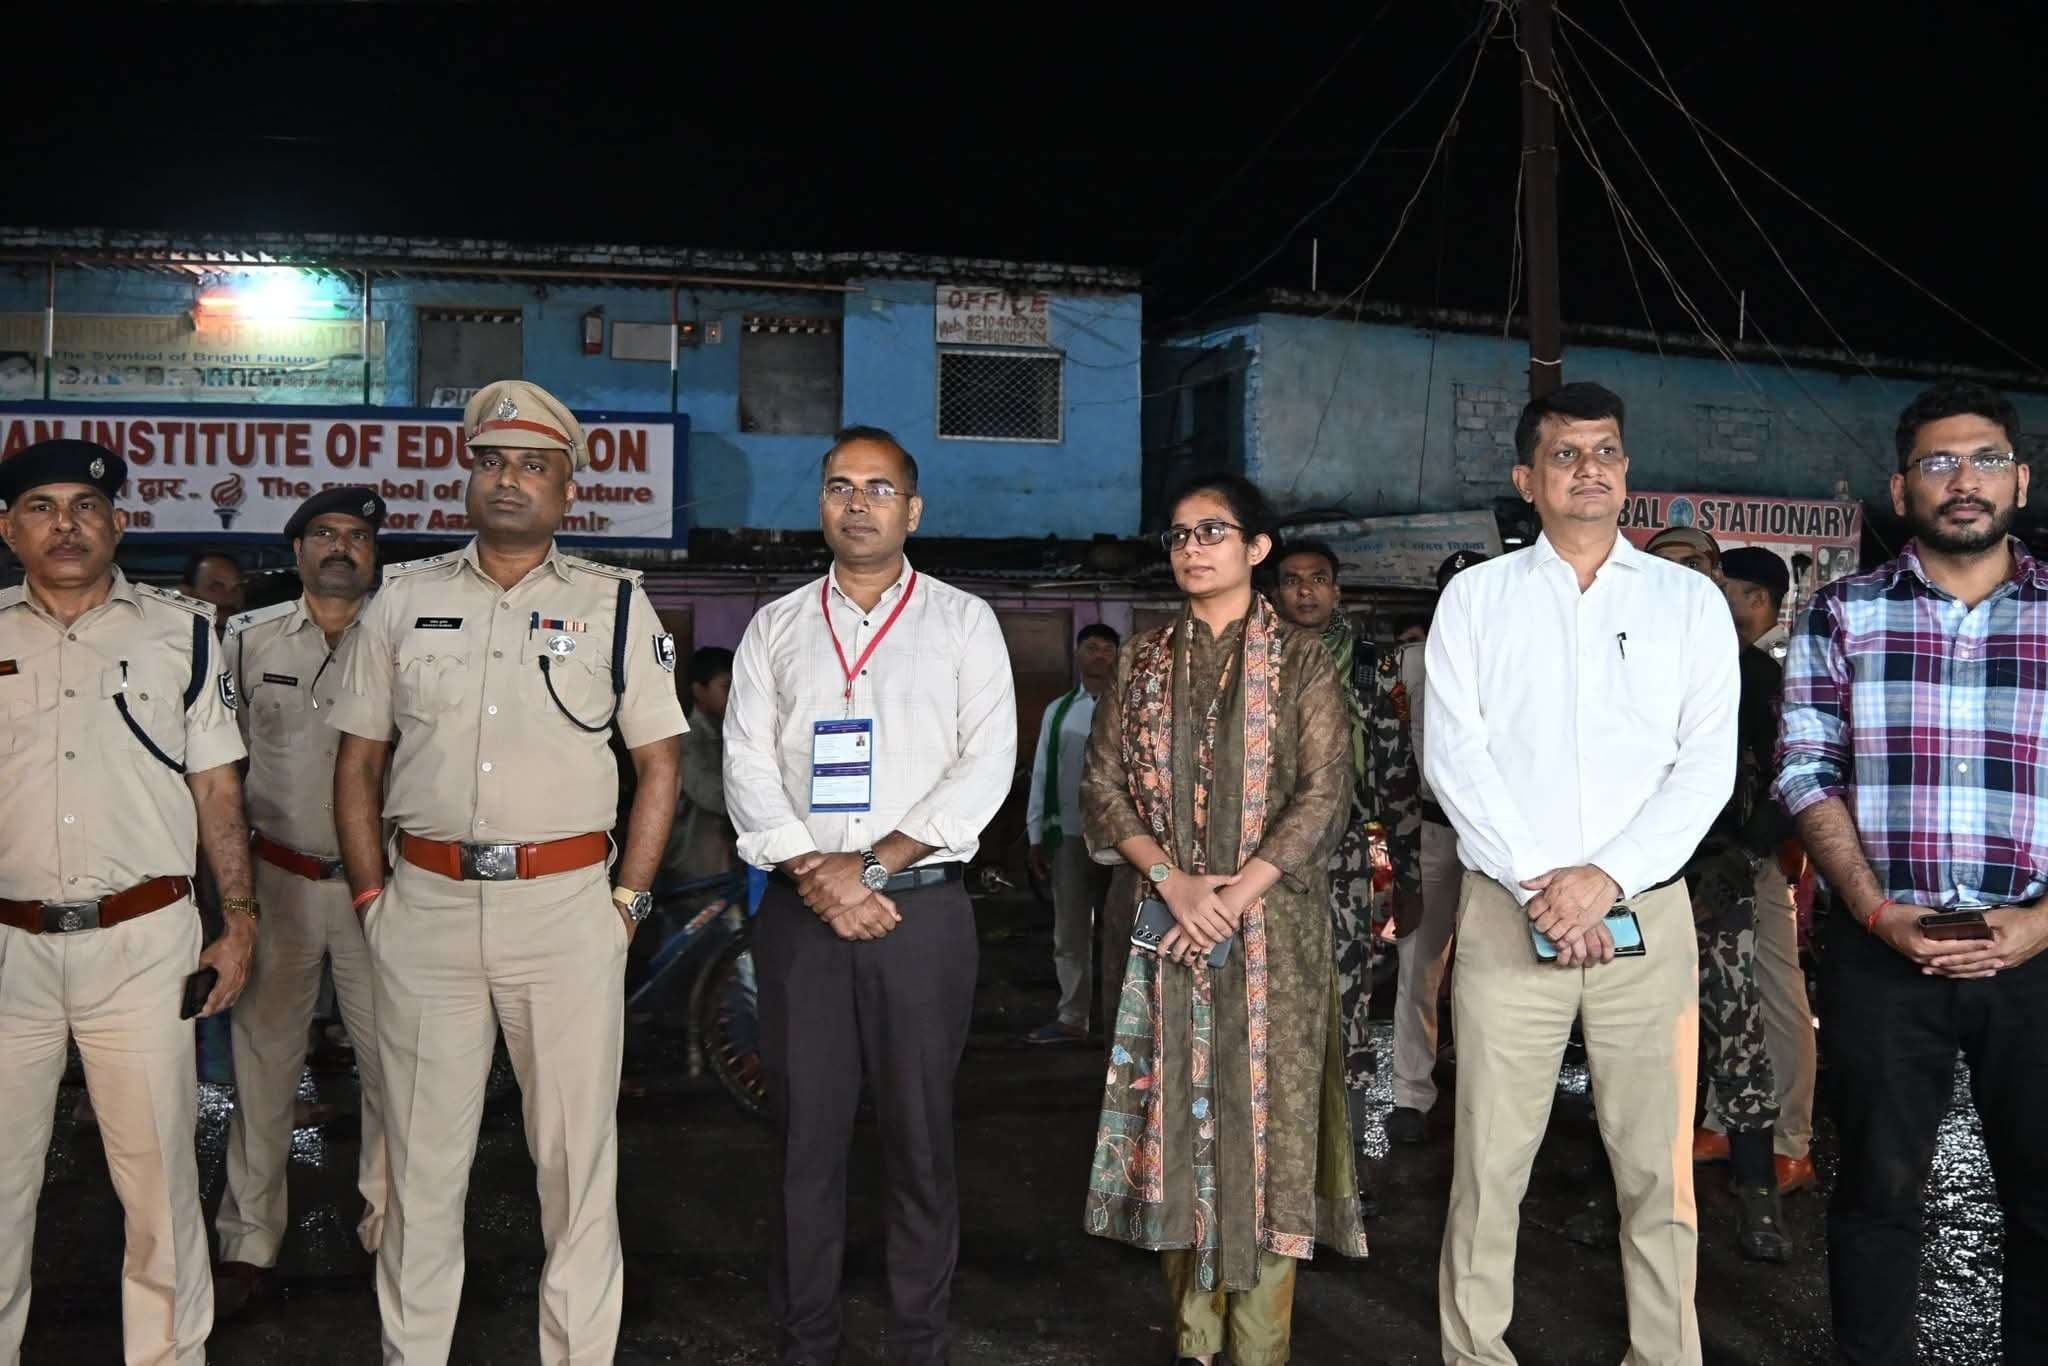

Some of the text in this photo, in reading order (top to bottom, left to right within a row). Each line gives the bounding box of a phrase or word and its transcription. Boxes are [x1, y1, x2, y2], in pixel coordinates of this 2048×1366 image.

[169, 352, 186, 361] of
[193, 352, 249, 363] Bright
[325, 423, 383, 467] OF
[258, 477, 311, 498] The
[433, 479, 462, 499] of
[1699, 499, 1856, 537] STATIONARY
